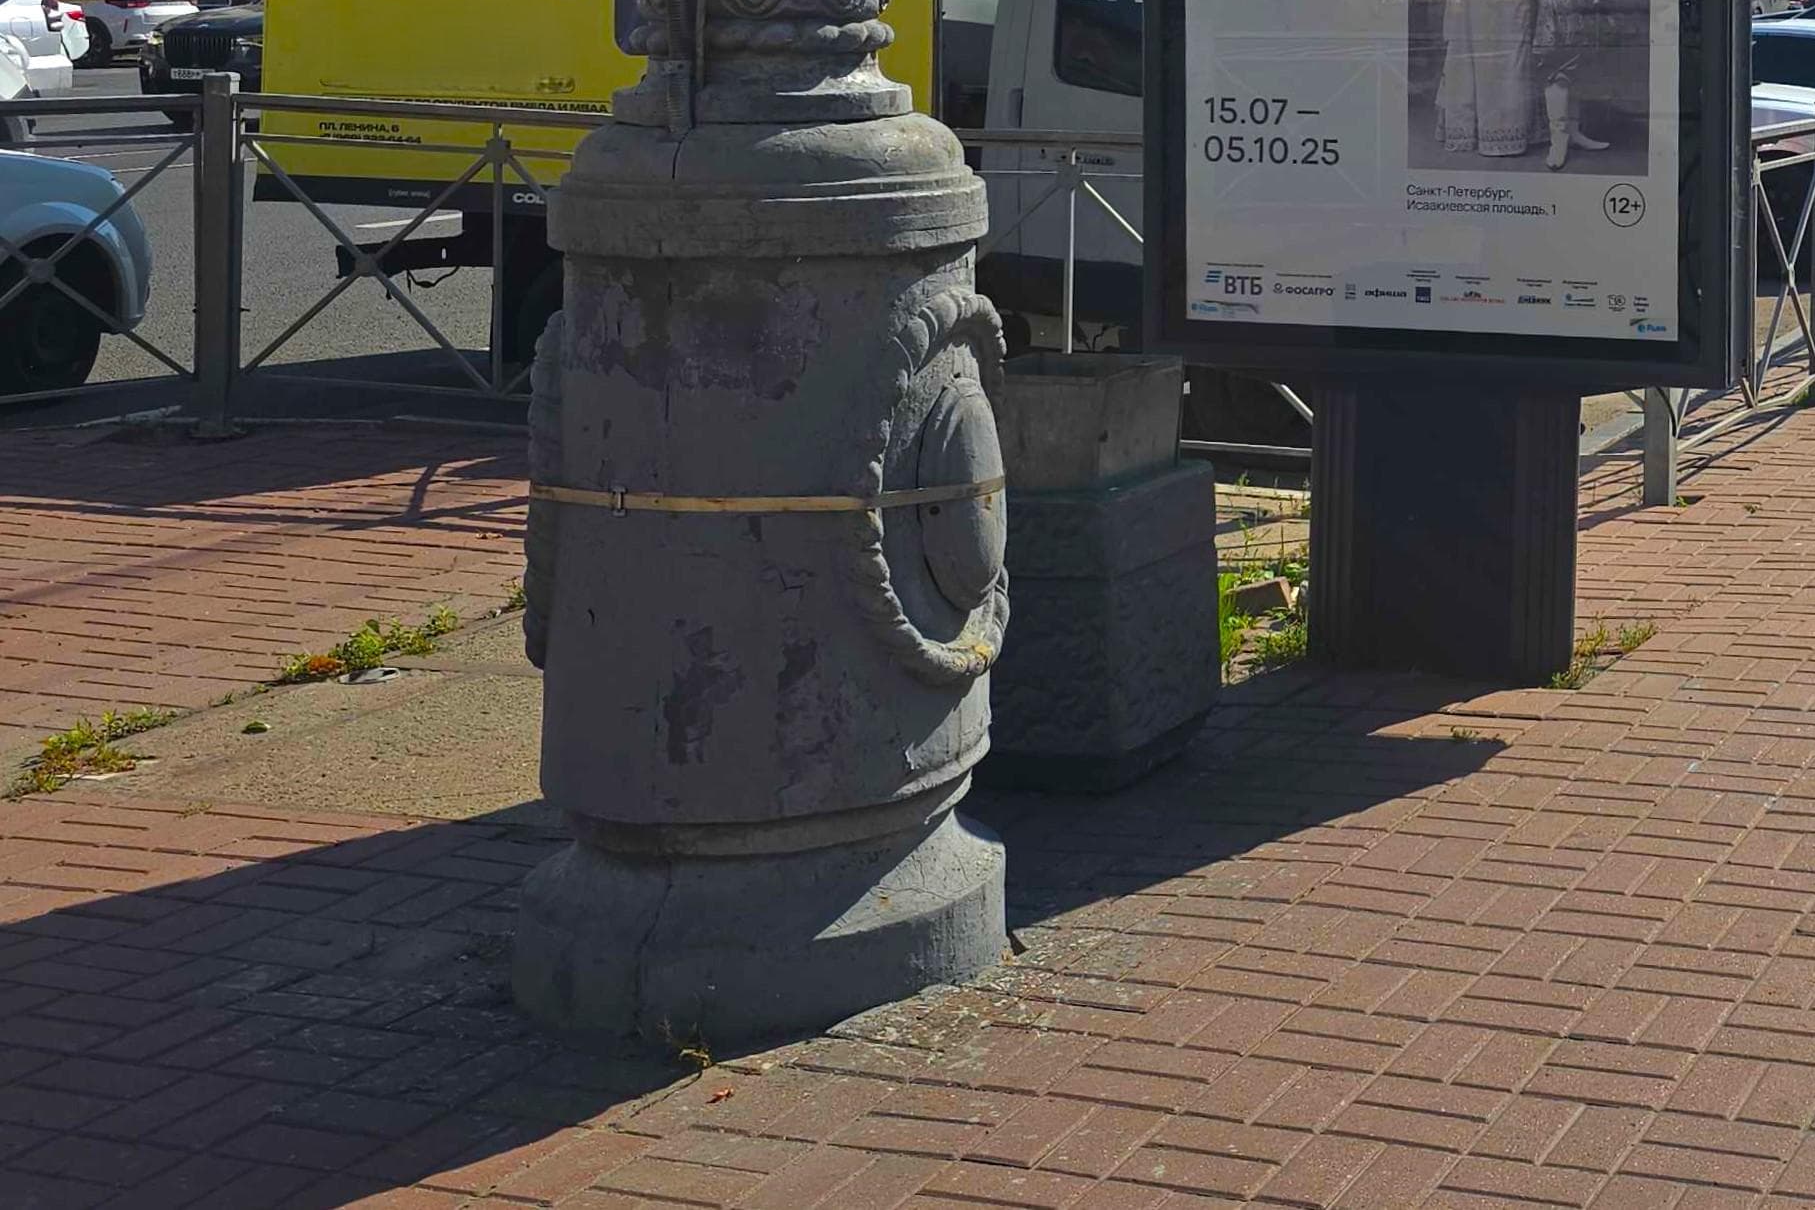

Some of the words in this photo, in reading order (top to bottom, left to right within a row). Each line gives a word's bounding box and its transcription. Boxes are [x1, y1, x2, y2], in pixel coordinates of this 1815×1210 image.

[319, 121, 337, 131] ПЛ.
[1204, 135, 1340, 166] 05.10.25
[1406, 184, 1514, 200] Санкт-Петербург,
[1406, 199, 1490, 213] Исаакиевская
[1492, 202, 1549, 217] площадь,
[1551, 204, 1557, 215] 1
[1608, 197, 1641, 215] 12+
[1224, 275, 1263, 296] ВТБ
[1285, 287, 1333, 297] ФОСАГРО
